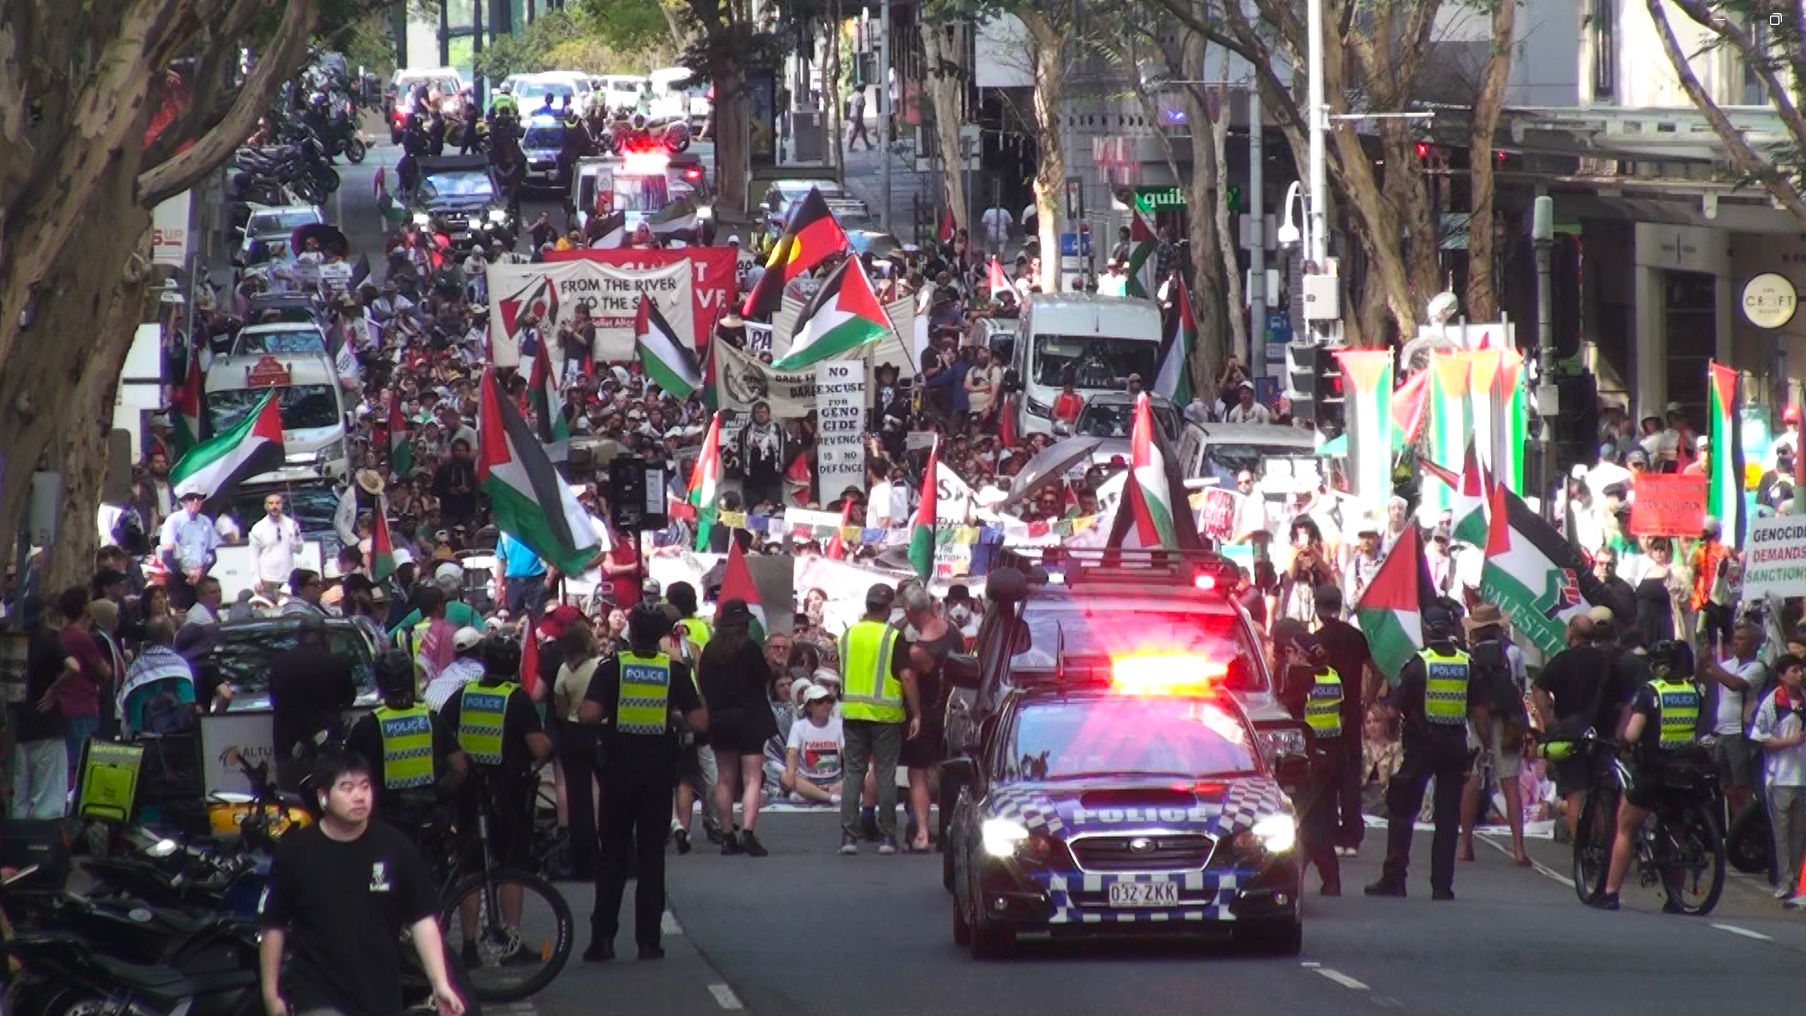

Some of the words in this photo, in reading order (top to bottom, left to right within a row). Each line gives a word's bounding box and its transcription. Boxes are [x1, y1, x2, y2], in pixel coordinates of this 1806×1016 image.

[561, 278, 600, 295] FROM
[604, 278, 631, 291] THE
[635, 277, 677, 291] RIVER
[578, 297, 599, 310] TO
[603, 296, 628, 310] THE
[632, 297, 660, 310] SA
[828, 367, 849, 377] NO
[817, 382, 865, 394] EXCUSE
[821, 407, 859, 418] GENO
[823, 420, 857, 431] CIDE
[818, 436, 862, 446] REVENGE
[824, 452, 833, 461] IS
[844, 451, 857, 460] NO
[820, 463, 863, 474] DEFENCE
[625, 668, 665, 682] POLICE
[1431, 665, 1466, 677] POLICE
[1311, 686, 1340, 696] POLICE
[465, 696, 501, 709] POLICE
[1664, 694, 1695, 705] POLICE
[386, 718, 426, 735] POLICE
[1073, 807, 1208, 824] POLICE
